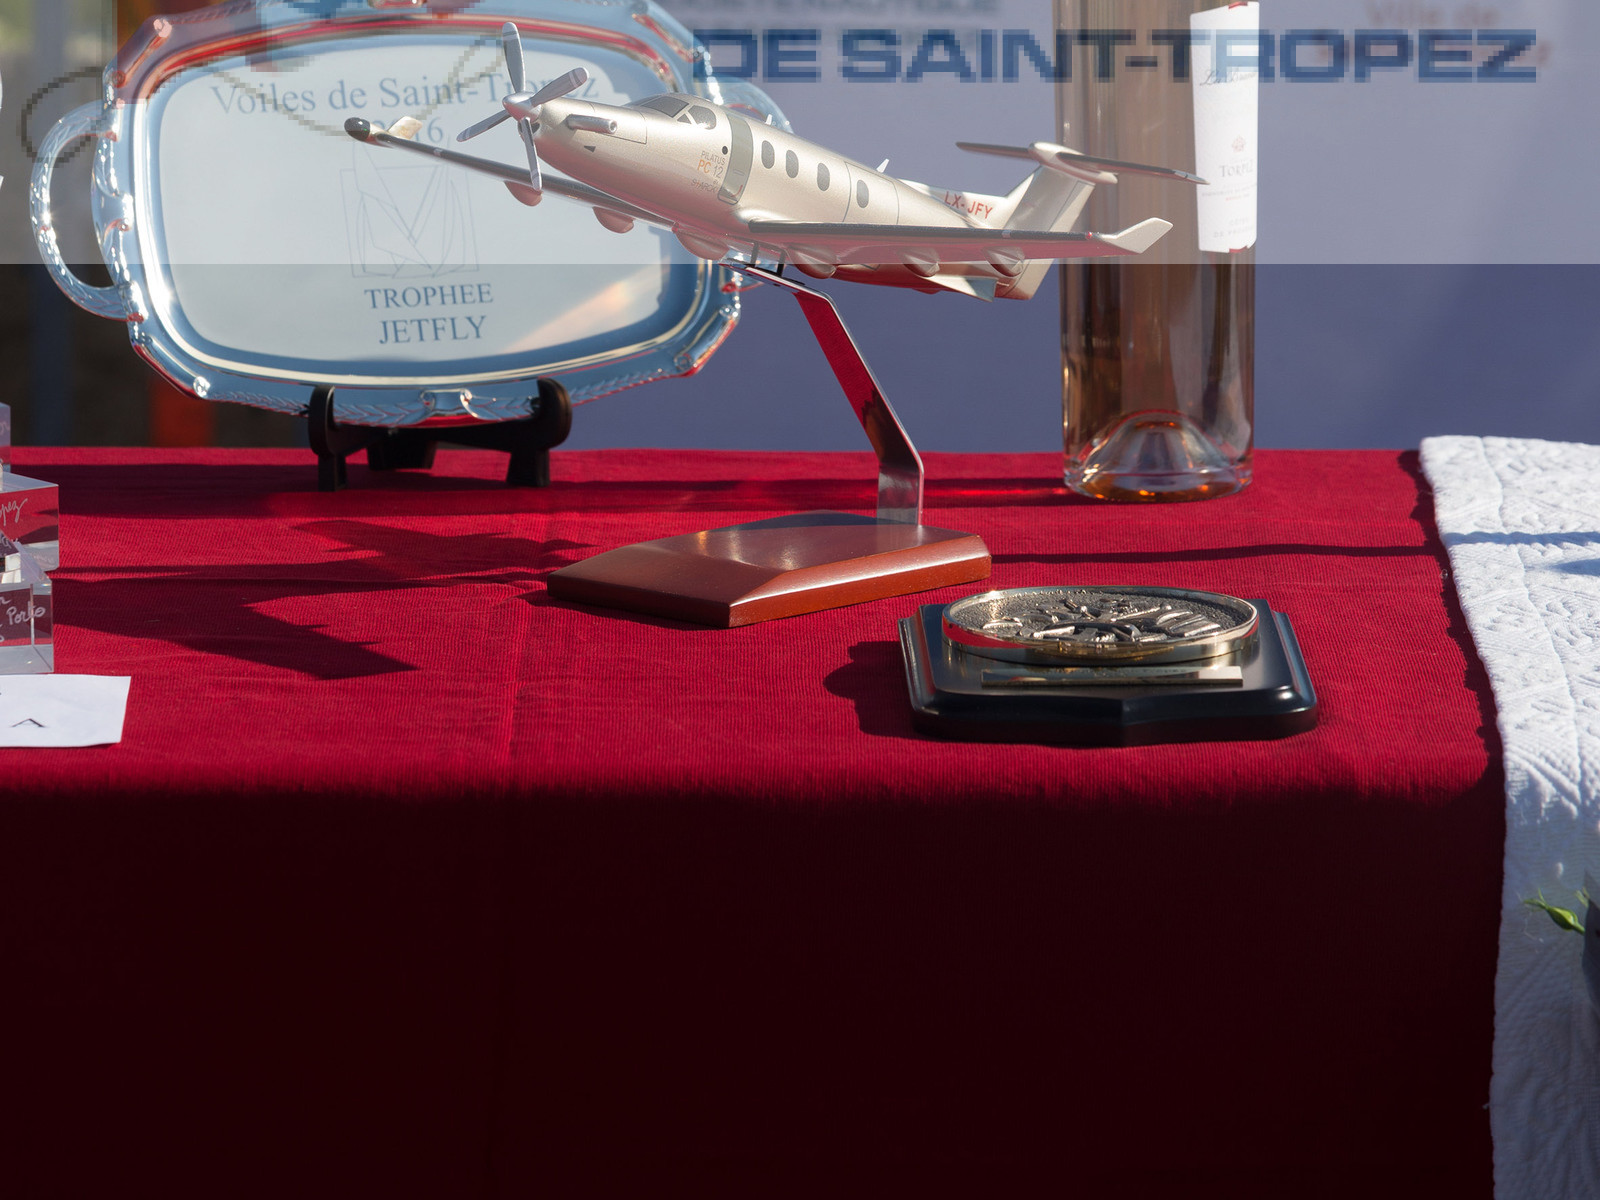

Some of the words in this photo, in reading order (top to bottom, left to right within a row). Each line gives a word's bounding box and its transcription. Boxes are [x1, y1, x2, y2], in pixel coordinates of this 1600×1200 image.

[210, 82, 316, 115] Voiles
[328, 80, 367, 110] de
[379, 72, 600, 108] Saint-Trz
[697, 159, 712, 174] PC
[363, 283, 494, 310] TROPHEE
[378, 315, 488, 345] JETFLY
